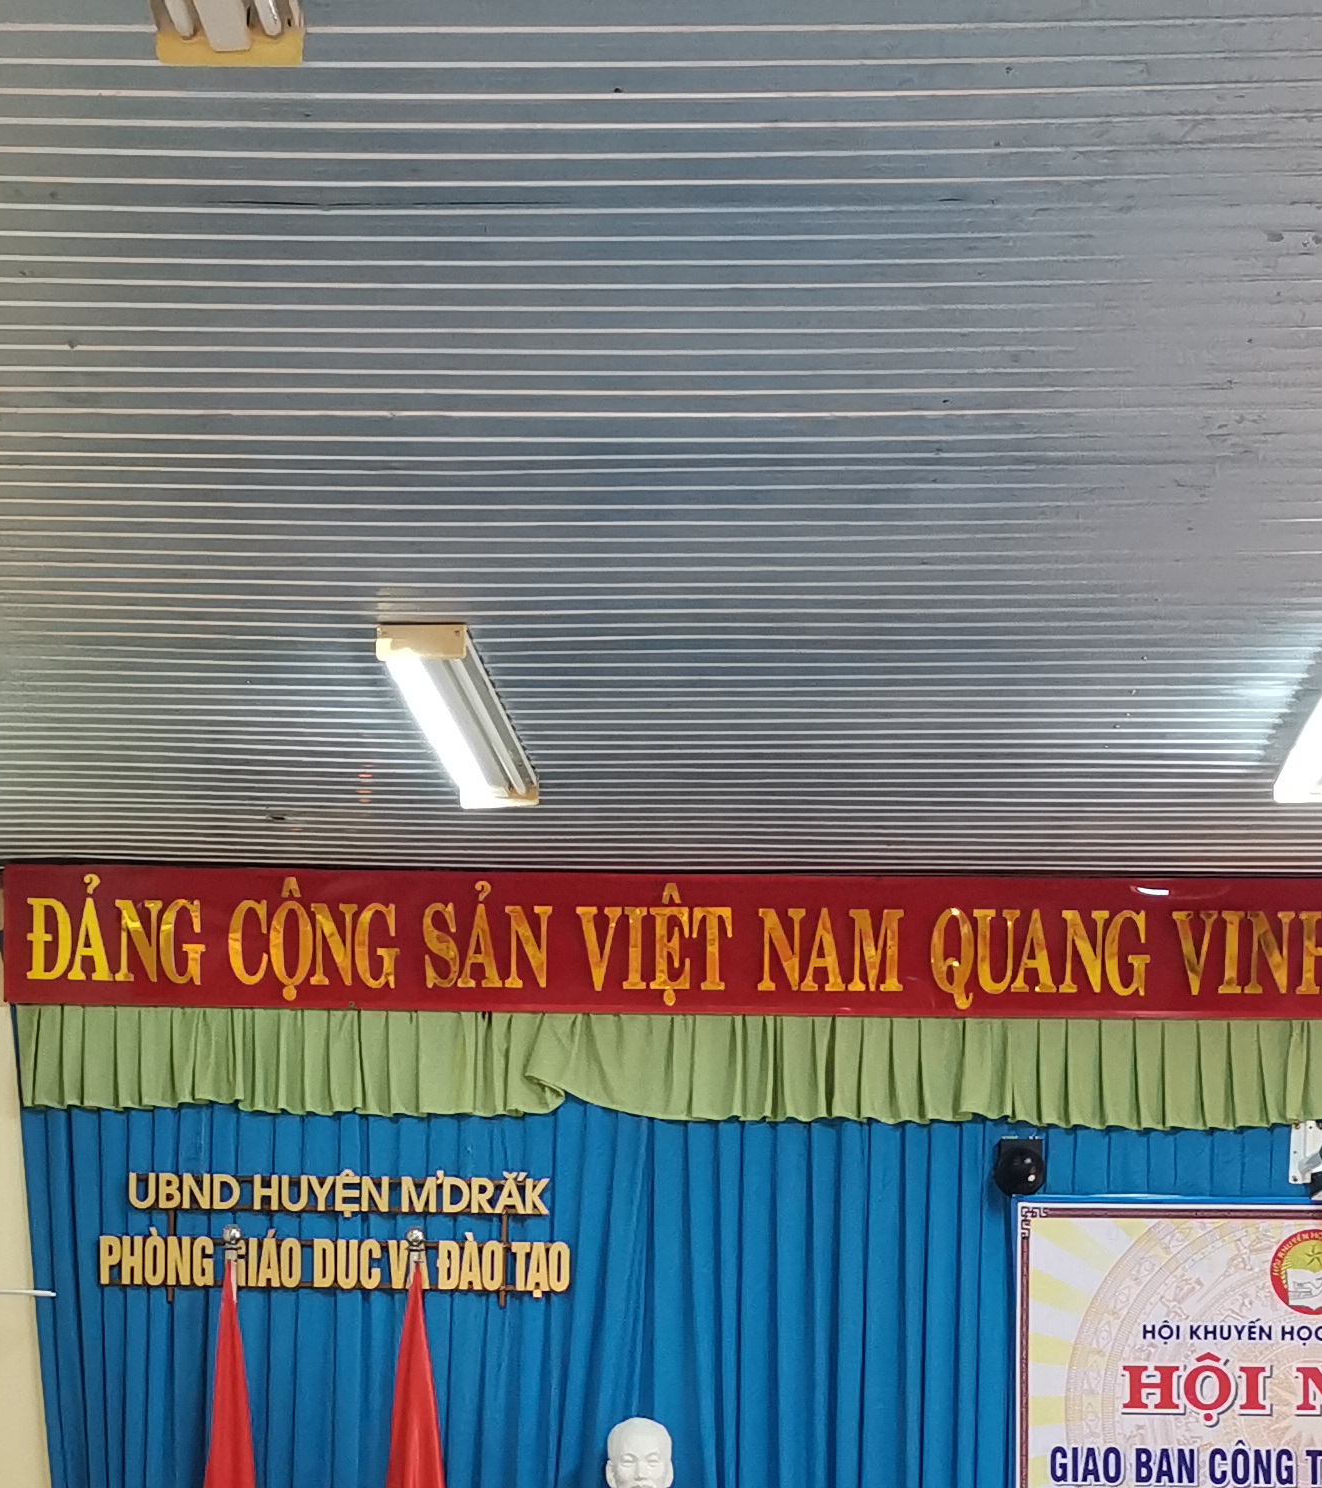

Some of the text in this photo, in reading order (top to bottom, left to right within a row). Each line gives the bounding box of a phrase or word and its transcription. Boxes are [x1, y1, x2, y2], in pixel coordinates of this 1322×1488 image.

[26, 874, 202, 986] ĐẢNG
[229, 877, 400, 1000] CỘNG
[425, 880, 552, 989] SẢN
[576, 883, 733, 1006] VIỆT
[759, 907, 904, 993] NAM
[931, 907, 1151, 1010] QUANG
[129, 1172, 241, 1210] UBND
[253, 1168, 389, 1218] HUYỆN
[99, 1227, 215, 1287] PHÒNG
[436, 1232, 504, 1291] ĐÀO
[511, 1241, 570, 1298] TẠO
[1142, 1320, 1180, 1345] HỘI
[1190, 1318, 1272, 1341] KHUYẾN
[1122, 1352, 1269, 1424] HỘI
[1050, 1446, 1122, 1484] GIAO
[1135, 1447, 1196, 1485] BAN
[1209, 1440, 1294, 1486] CÔNG
